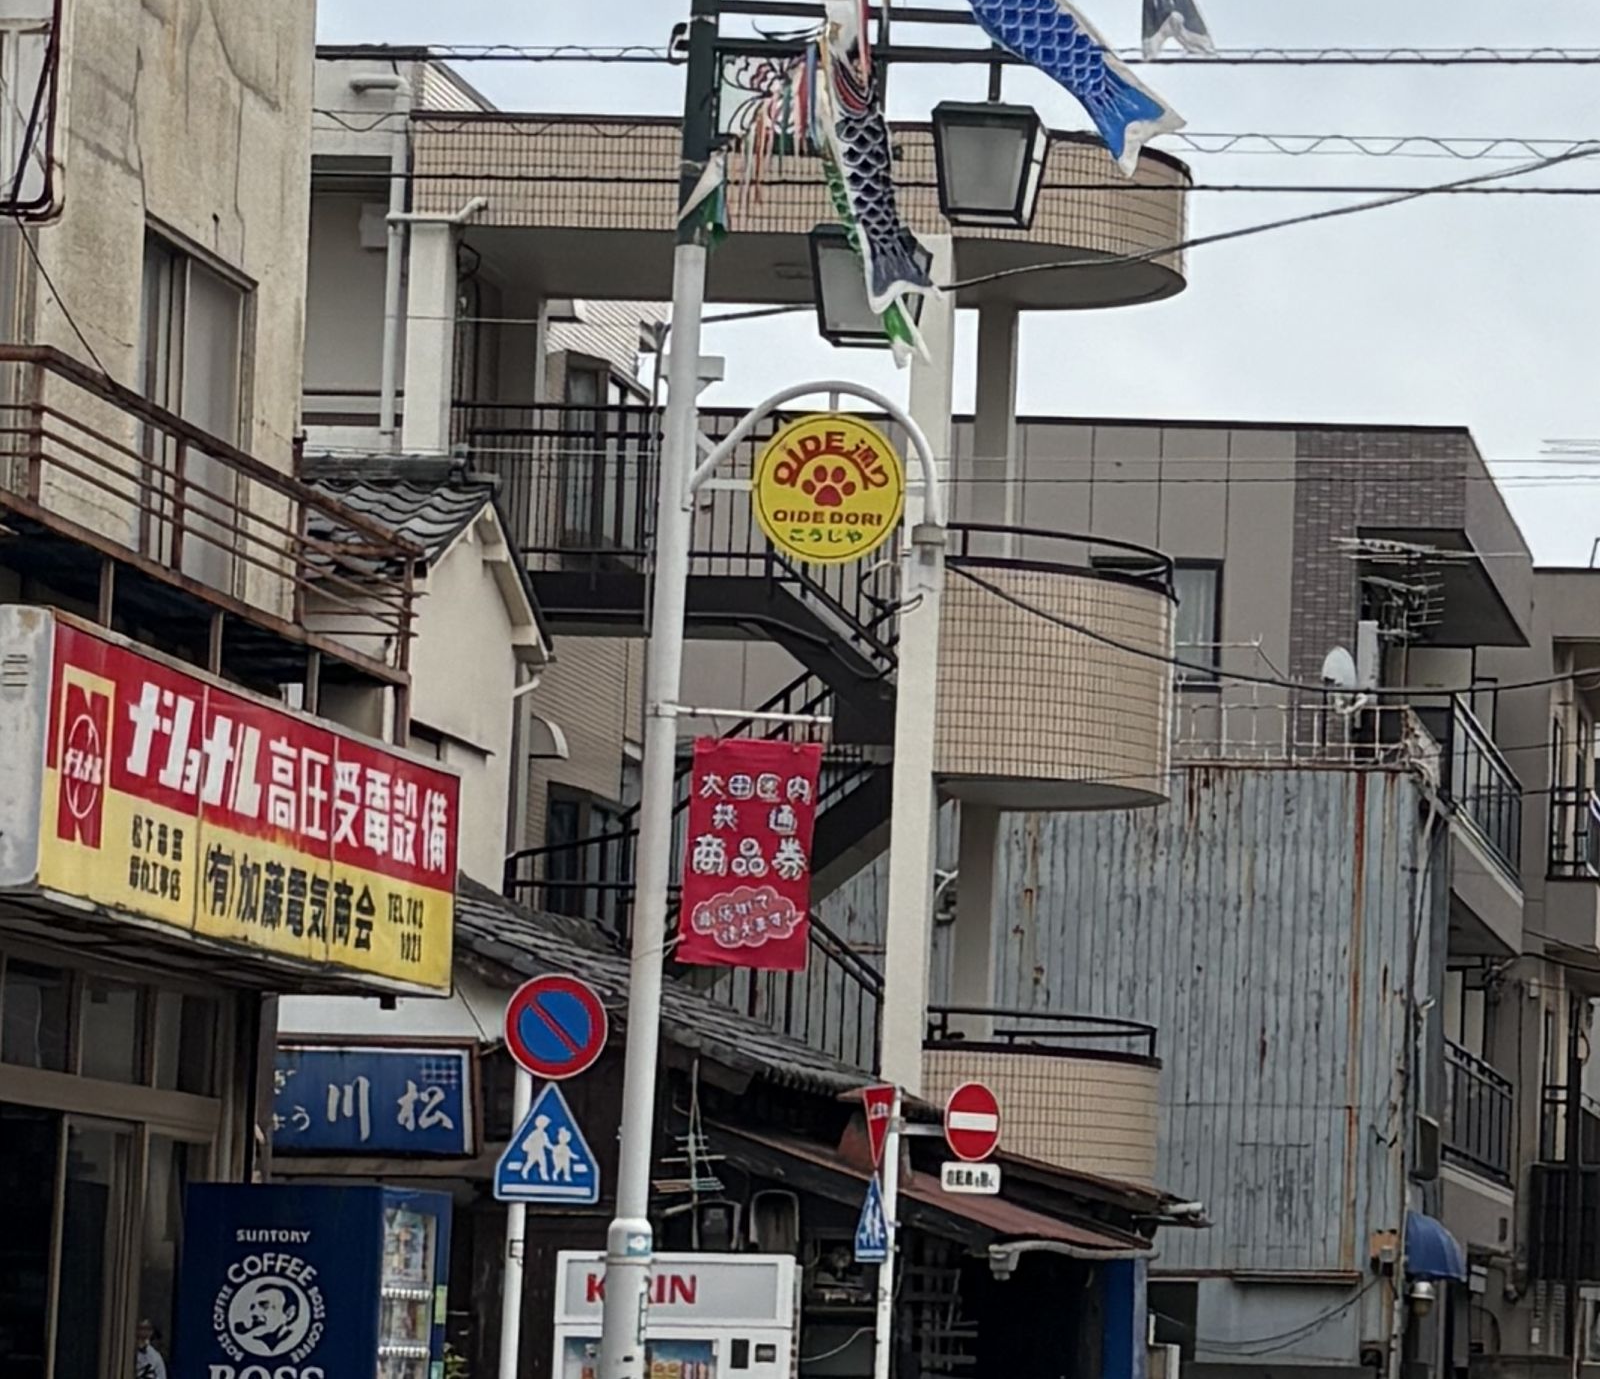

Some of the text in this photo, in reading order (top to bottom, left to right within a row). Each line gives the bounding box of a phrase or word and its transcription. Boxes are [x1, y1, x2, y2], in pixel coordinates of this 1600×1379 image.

[773, 509, 883, 526] OIDE DORI
[789, 528, 863, 544] こうじや
[126, 681, 449, 876] ナショナル 高圧受電設備
[692, 834, 808, 881] 商品券
[203, 841, 376, 952] (有)加藤電気商会
[387, 891, 404, 924] TEL
[236, 1229, 311, 1244] SUNTORY
[227, 1252, 318, 1287] COFFEE
[586, 1273, 698, 1305] KIN
